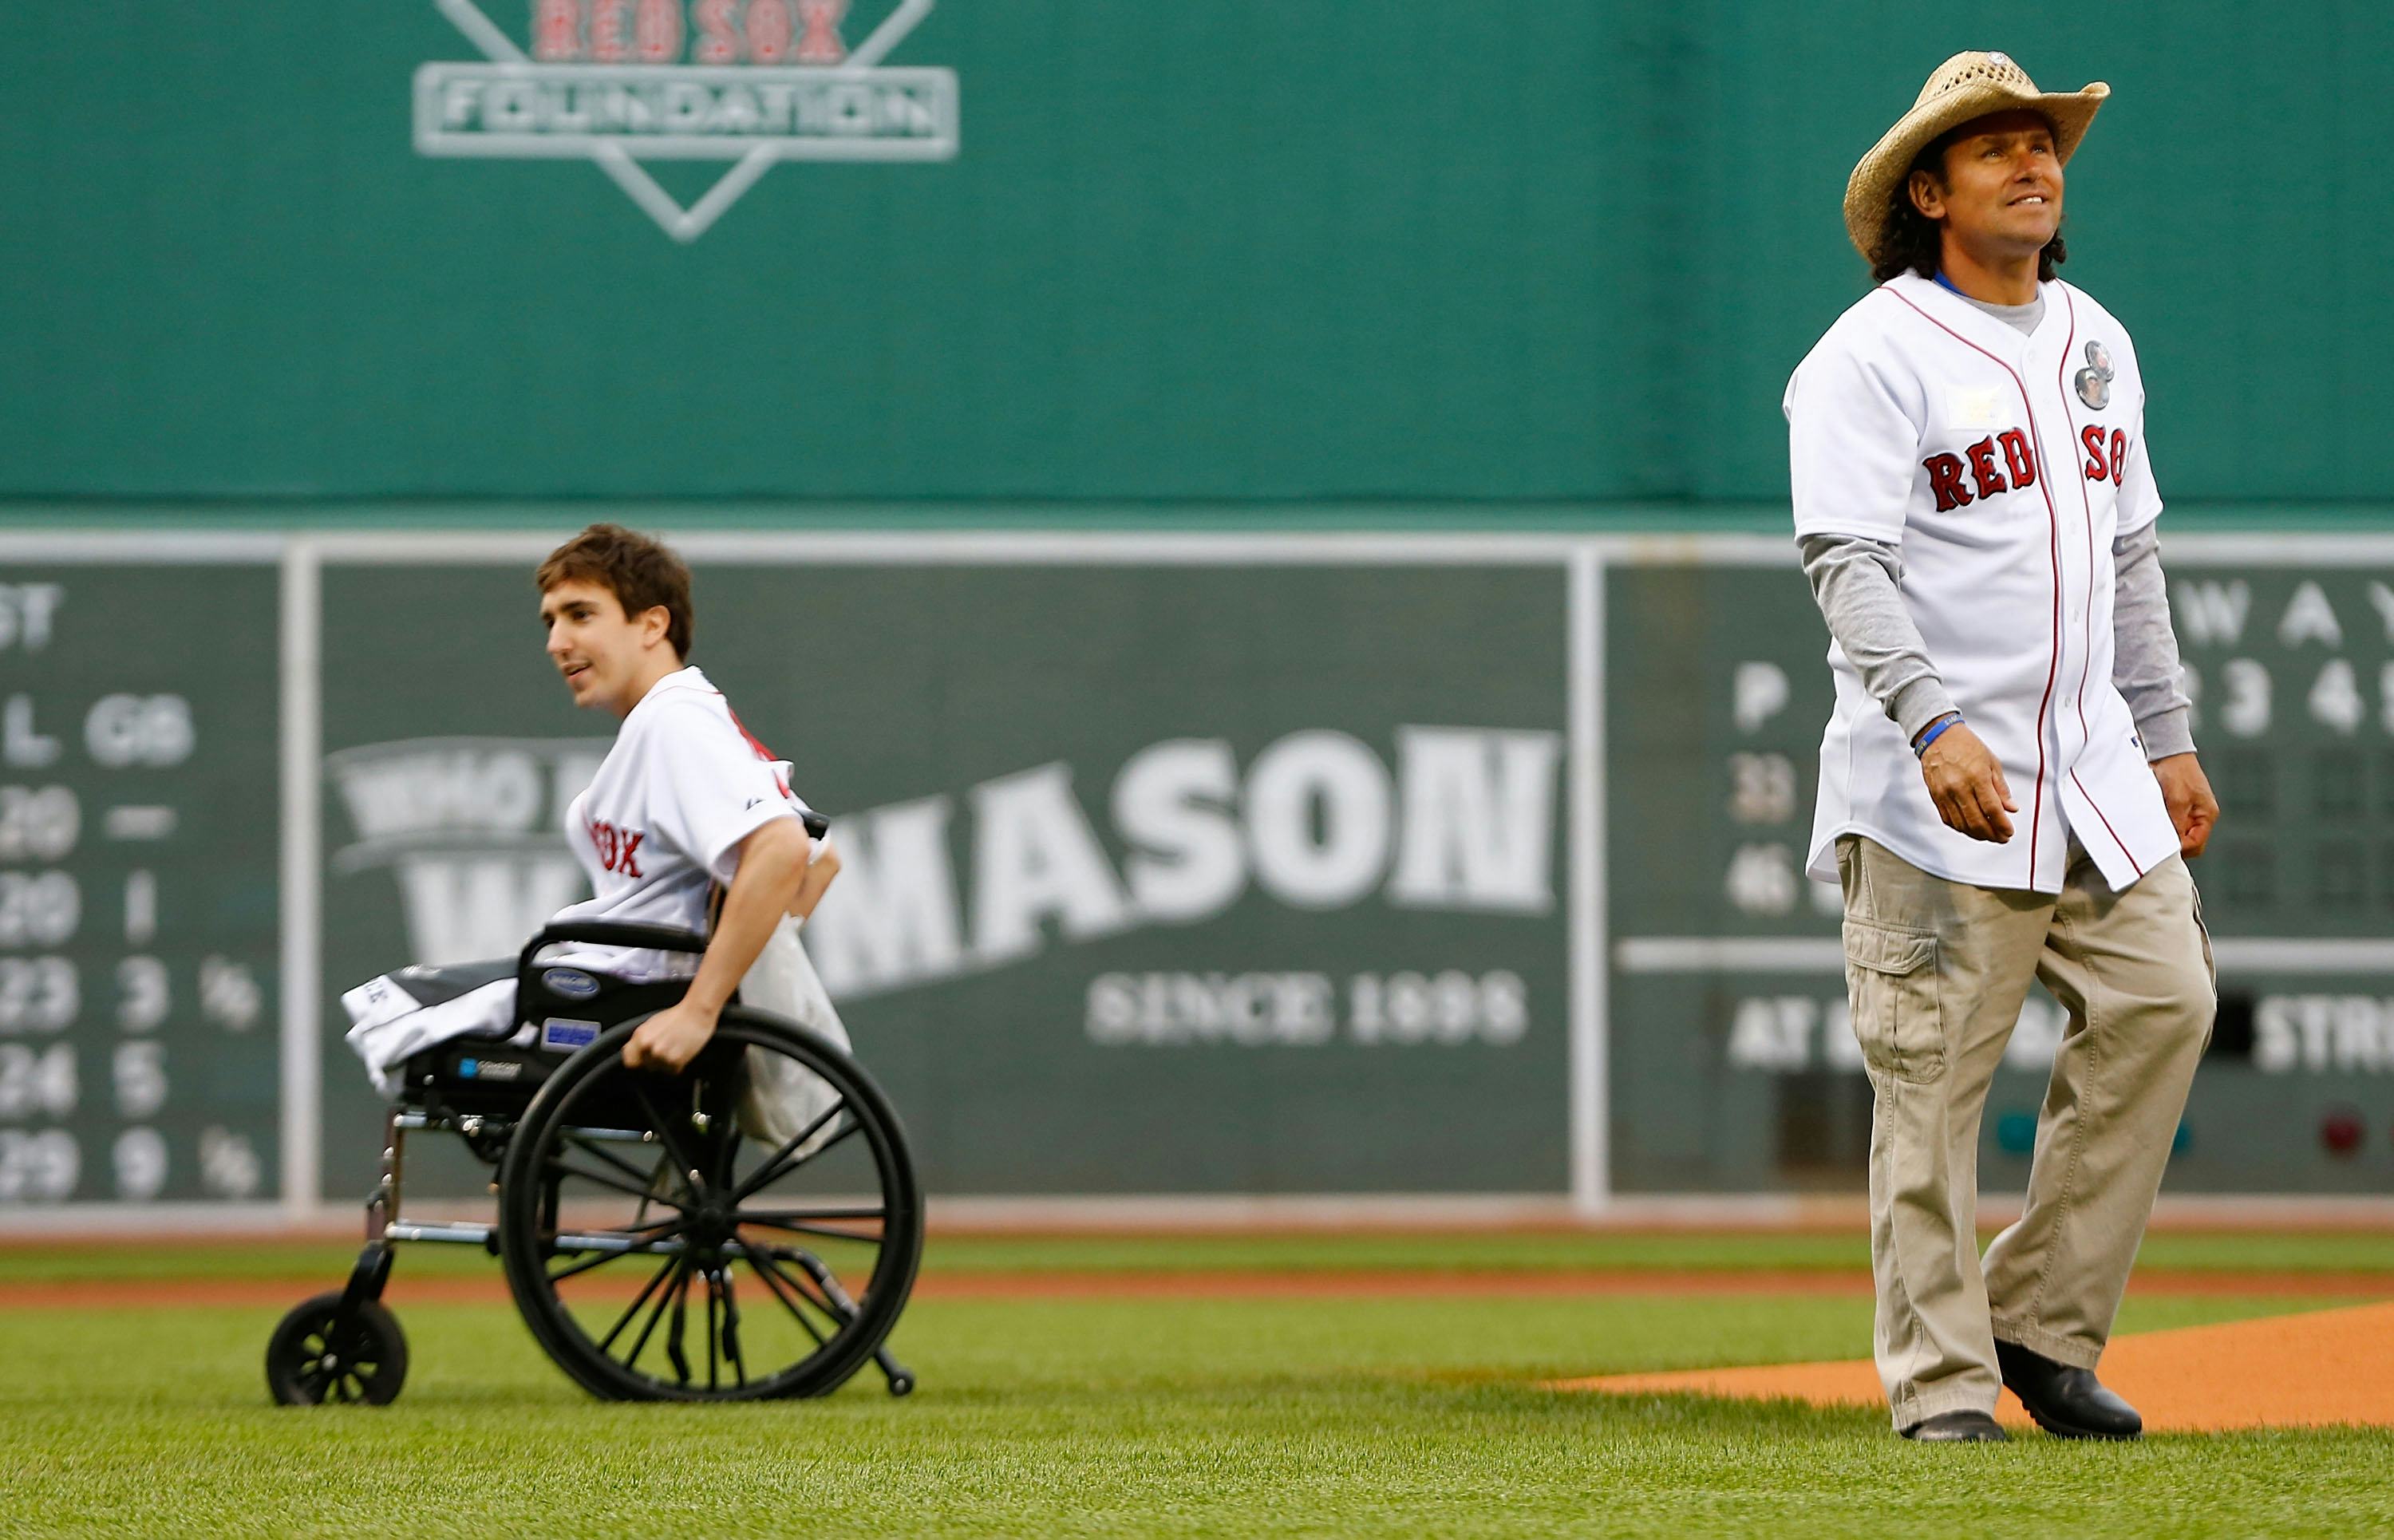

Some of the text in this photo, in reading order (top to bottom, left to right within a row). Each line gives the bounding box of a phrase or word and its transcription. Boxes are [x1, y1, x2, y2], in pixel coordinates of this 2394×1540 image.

[531, 0, 847, 64] RED SOX
[437, 81, 937, 136] FOUNDATION
[1922, 424, 2128, 513] RED SO
[3, 693, 196, 768] L GB
[1732, 661, 1788, 731] P
[2222, 659, 2273, 736] 3
[2310, 659, 2364, 735] 4
[342, 750, 539, 838] WHO
[591, 820, 645, 879] OX
[804, 723, 1562, 1002] MASON
[116, 956, 171, 1033] 3
[1086, 970, 1336, 1047] SINCE
[1729, 995, 1816, 1073] AT
[113, 1041, 168, 1117] 5
[113, 1127, 169, 1201] 9
